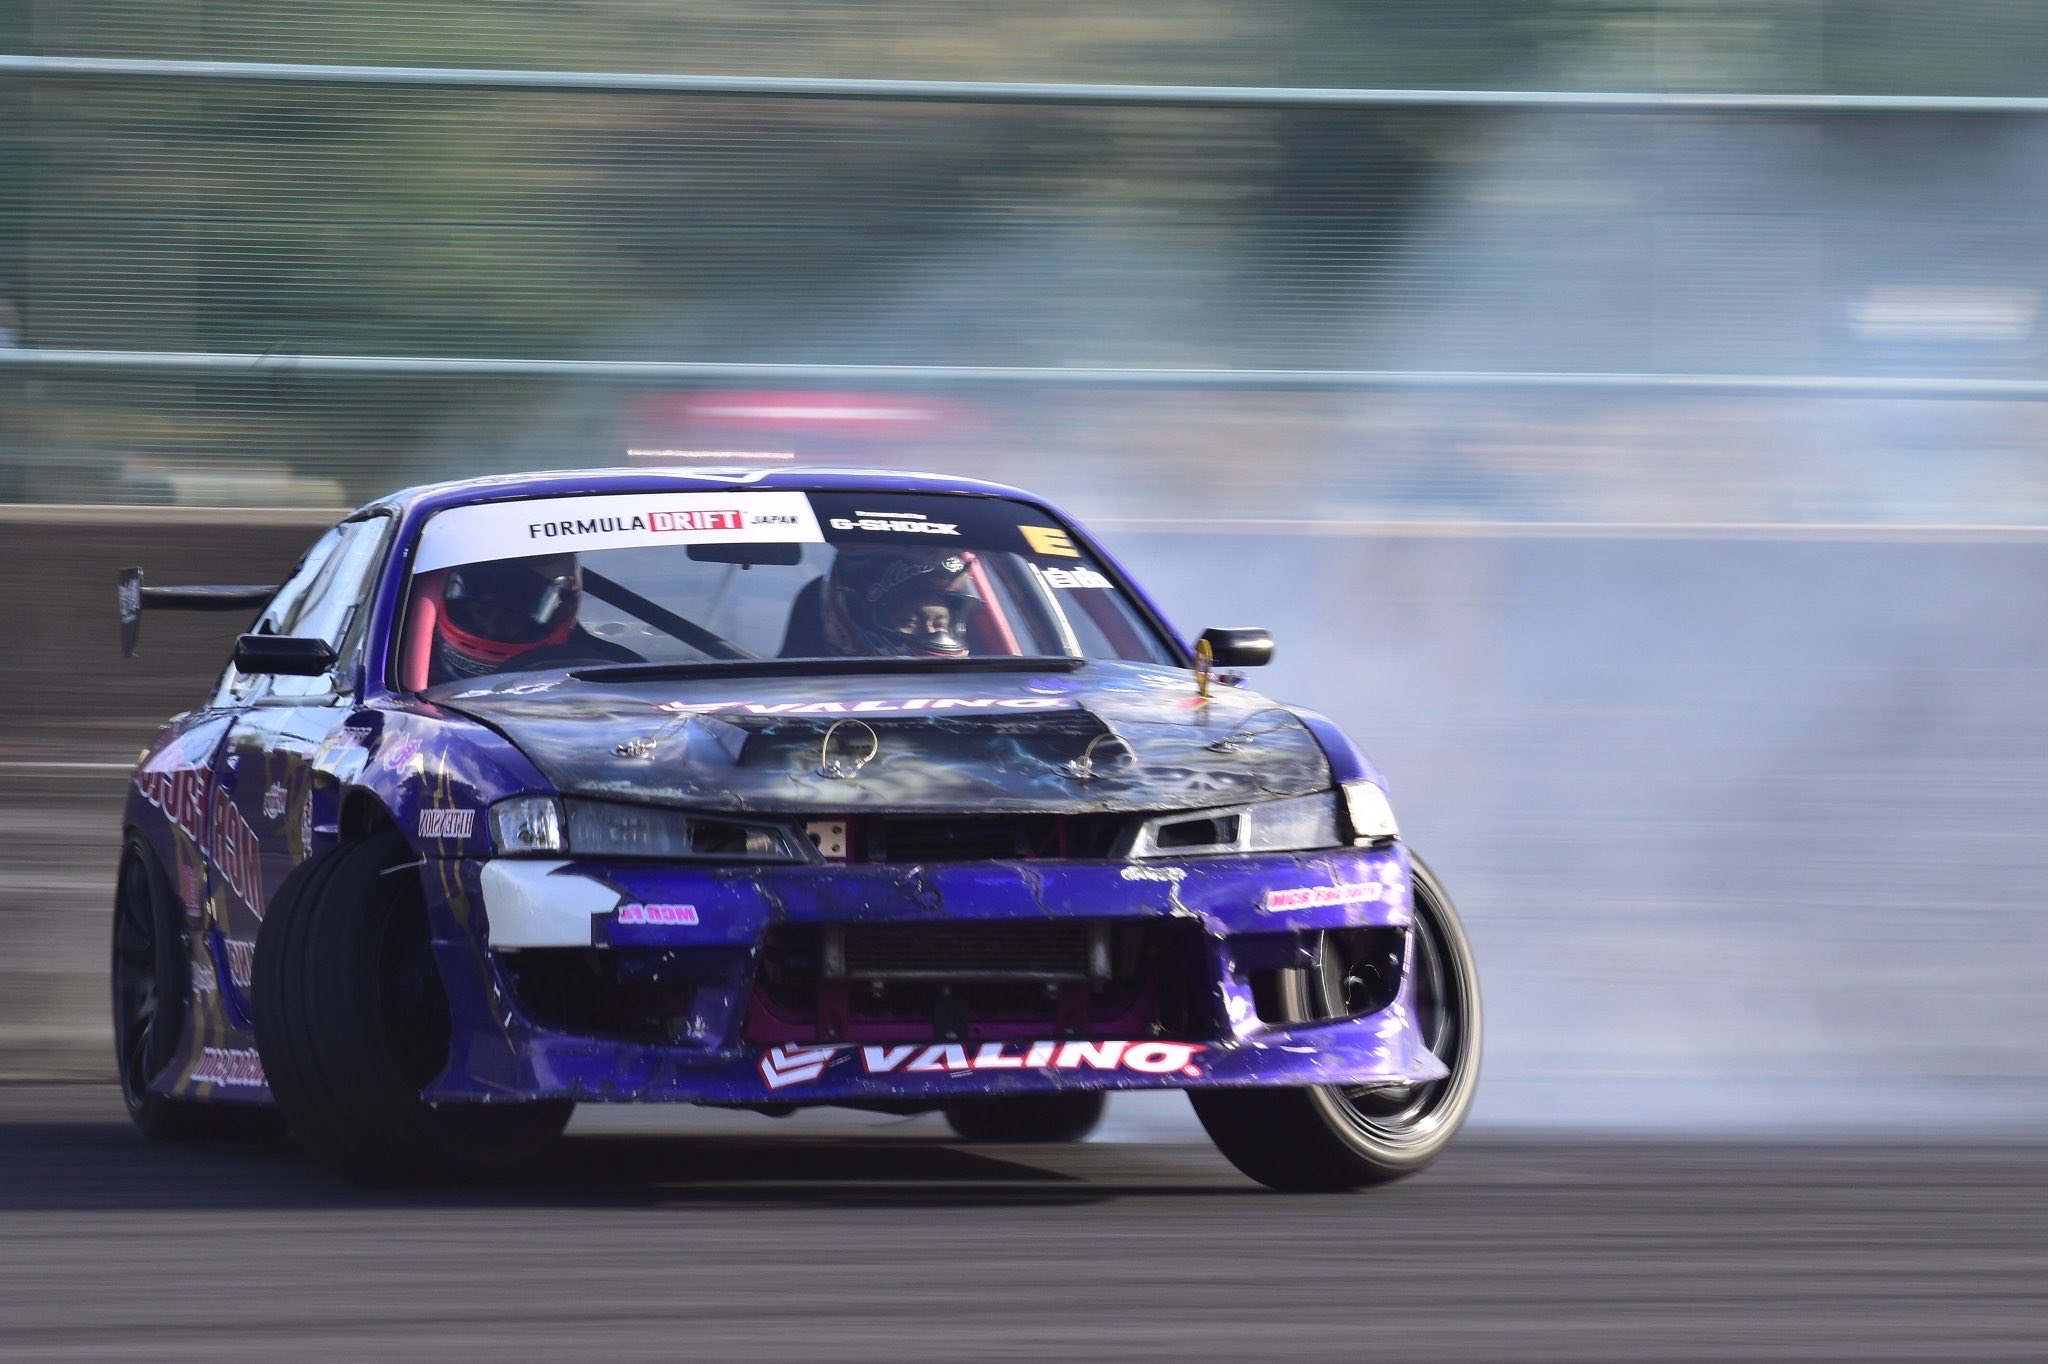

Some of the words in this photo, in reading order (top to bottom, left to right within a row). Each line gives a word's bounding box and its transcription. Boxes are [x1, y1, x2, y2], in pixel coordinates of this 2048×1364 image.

[529, 516, 646, 539] FORMULA
[651, 510, 741, 532] DRIFT
[751, 515, 799, 526] JAPAN
[830, 518, 962, 536] G-SHOCK
[1018, 525, 1081, 557] E
[743, 697, 1067, 714] VALINO
[861, 1040, 1199, 1074] VALINO
